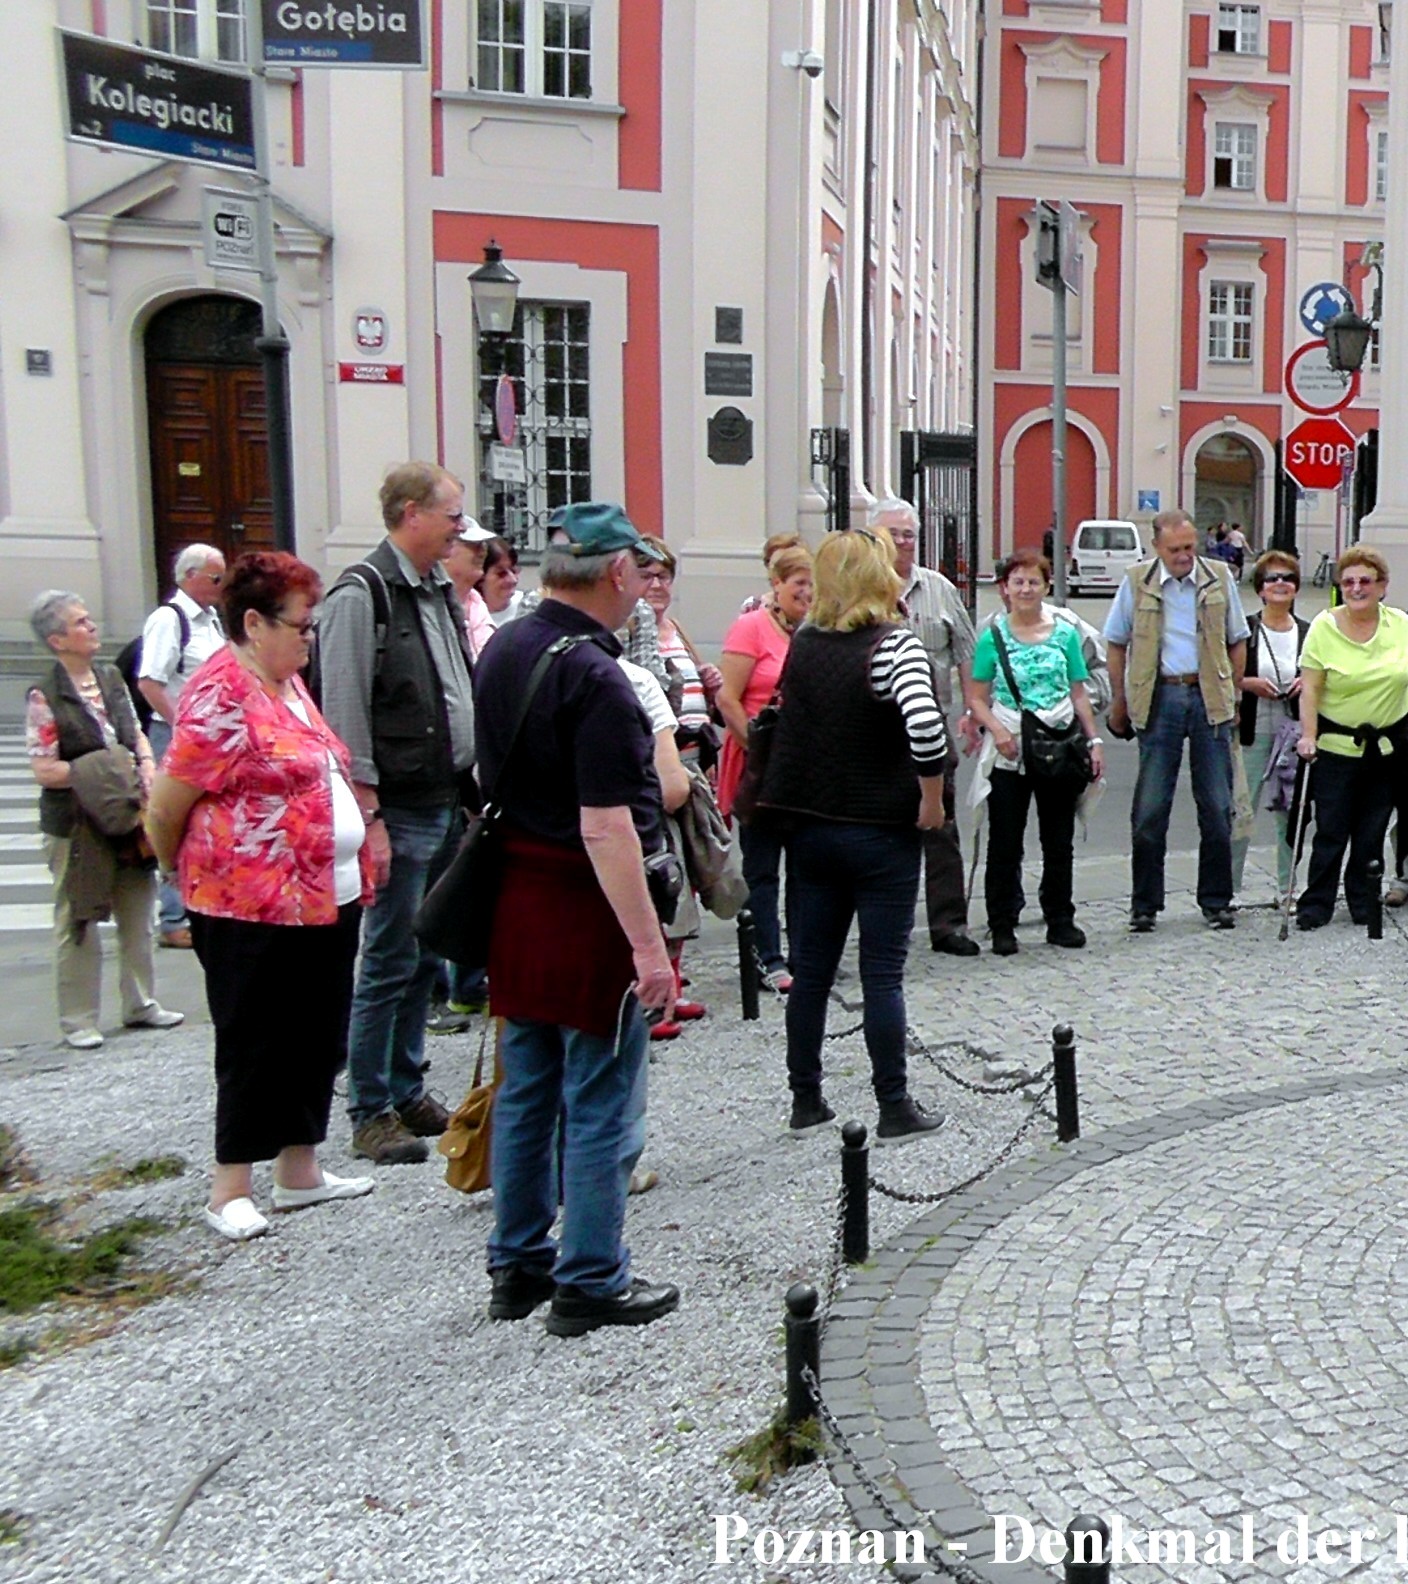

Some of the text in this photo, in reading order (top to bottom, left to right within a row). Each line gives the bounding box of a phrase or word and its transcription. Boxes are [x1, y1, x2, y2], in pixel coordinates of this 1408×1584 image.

[276, 1, 407, 40] Gołębia
[144, 62, 177, 82] plac
[86, 73, 234, 135] Kolegiacki
[1291, 441, 1350, 466] STOP
